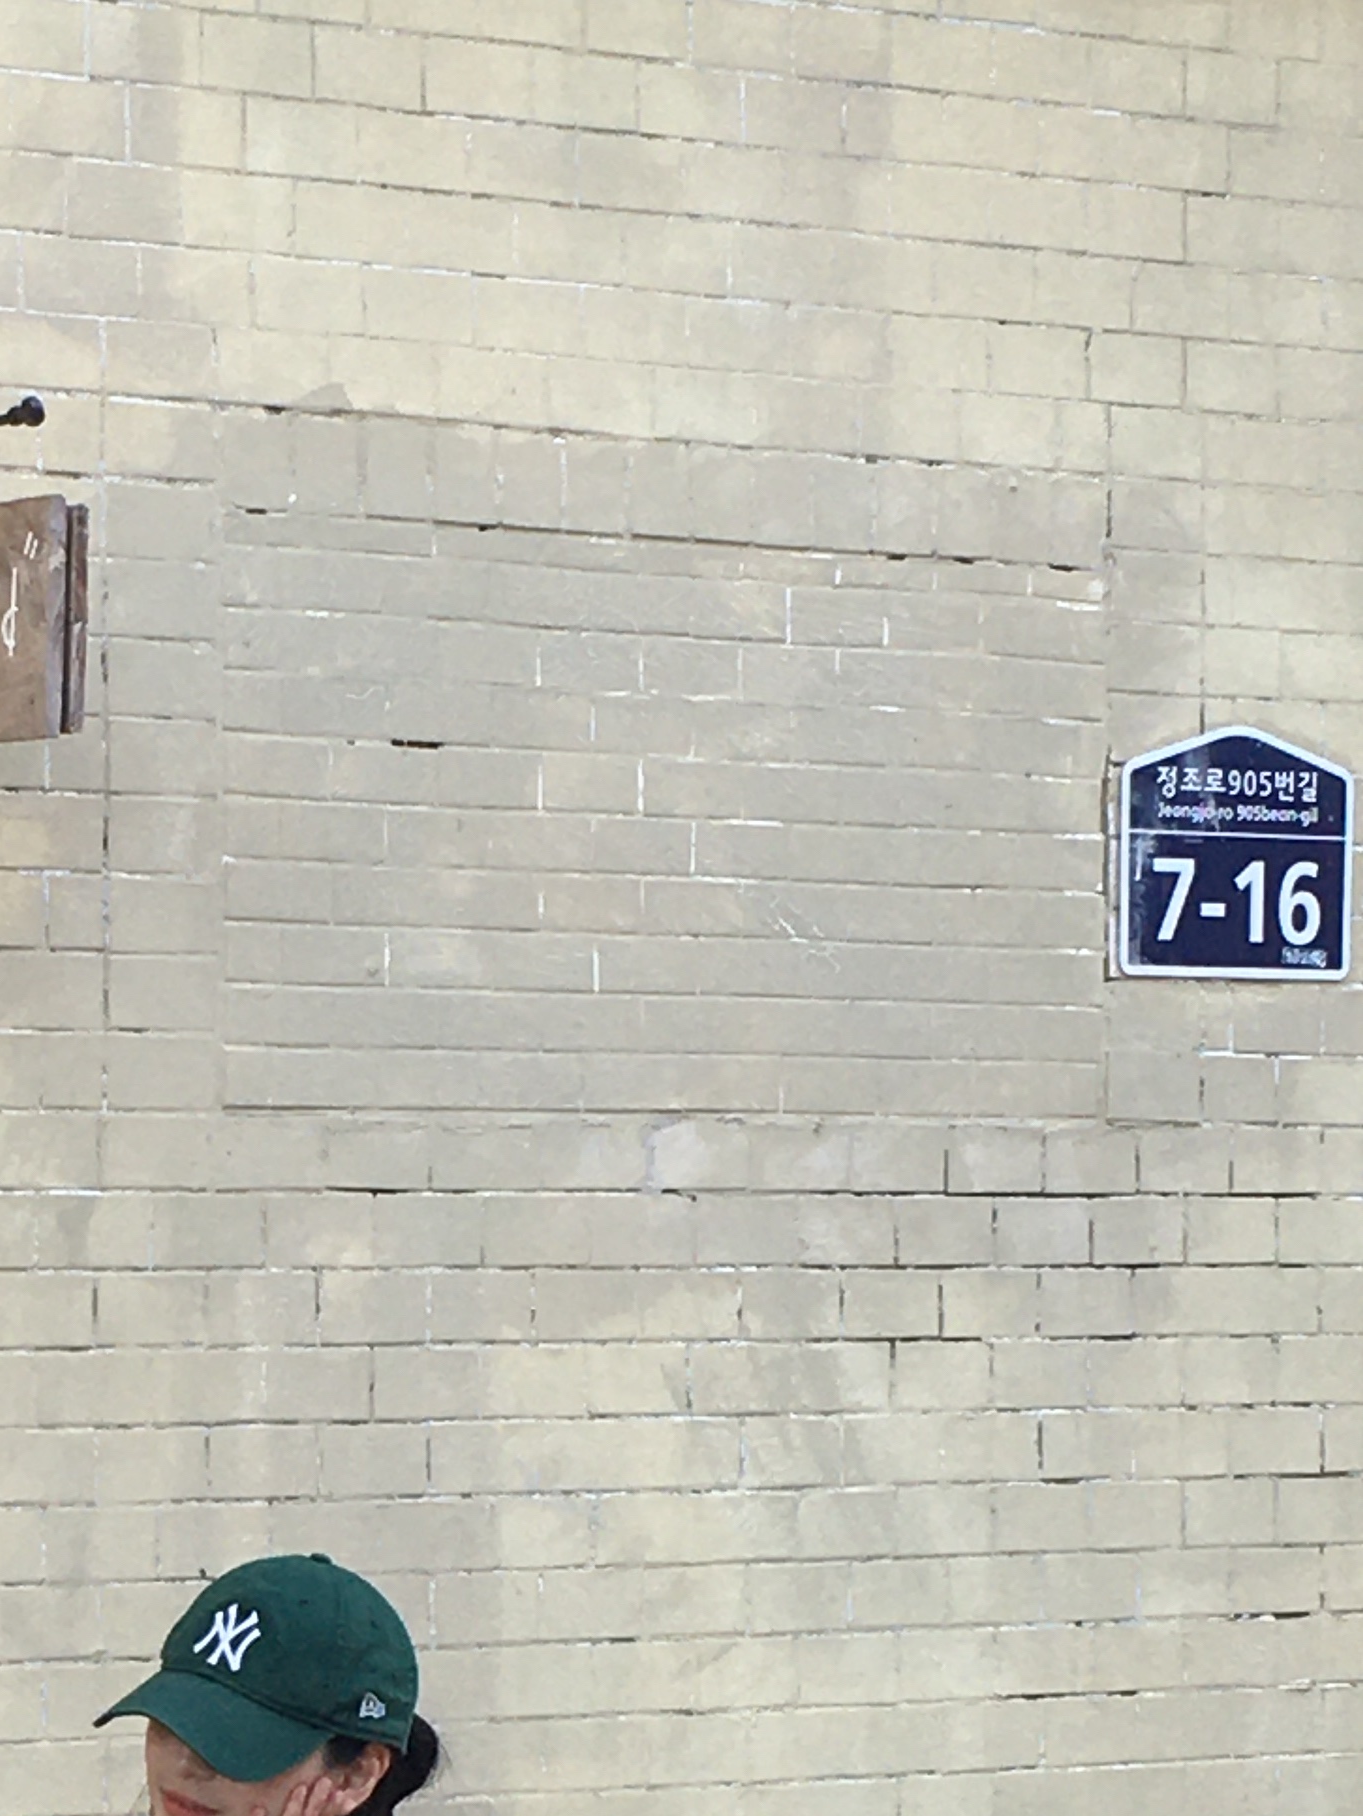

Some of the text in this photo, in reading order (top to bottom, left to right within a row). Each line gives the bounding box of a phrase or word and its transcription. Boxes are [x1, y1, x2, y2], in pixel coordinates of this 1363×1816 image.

[1156, 766, 1318, 803] 정조로905번길
[1152, 858, 1321, 945] 7-16
[193, 1603, 261, 1671] NY
